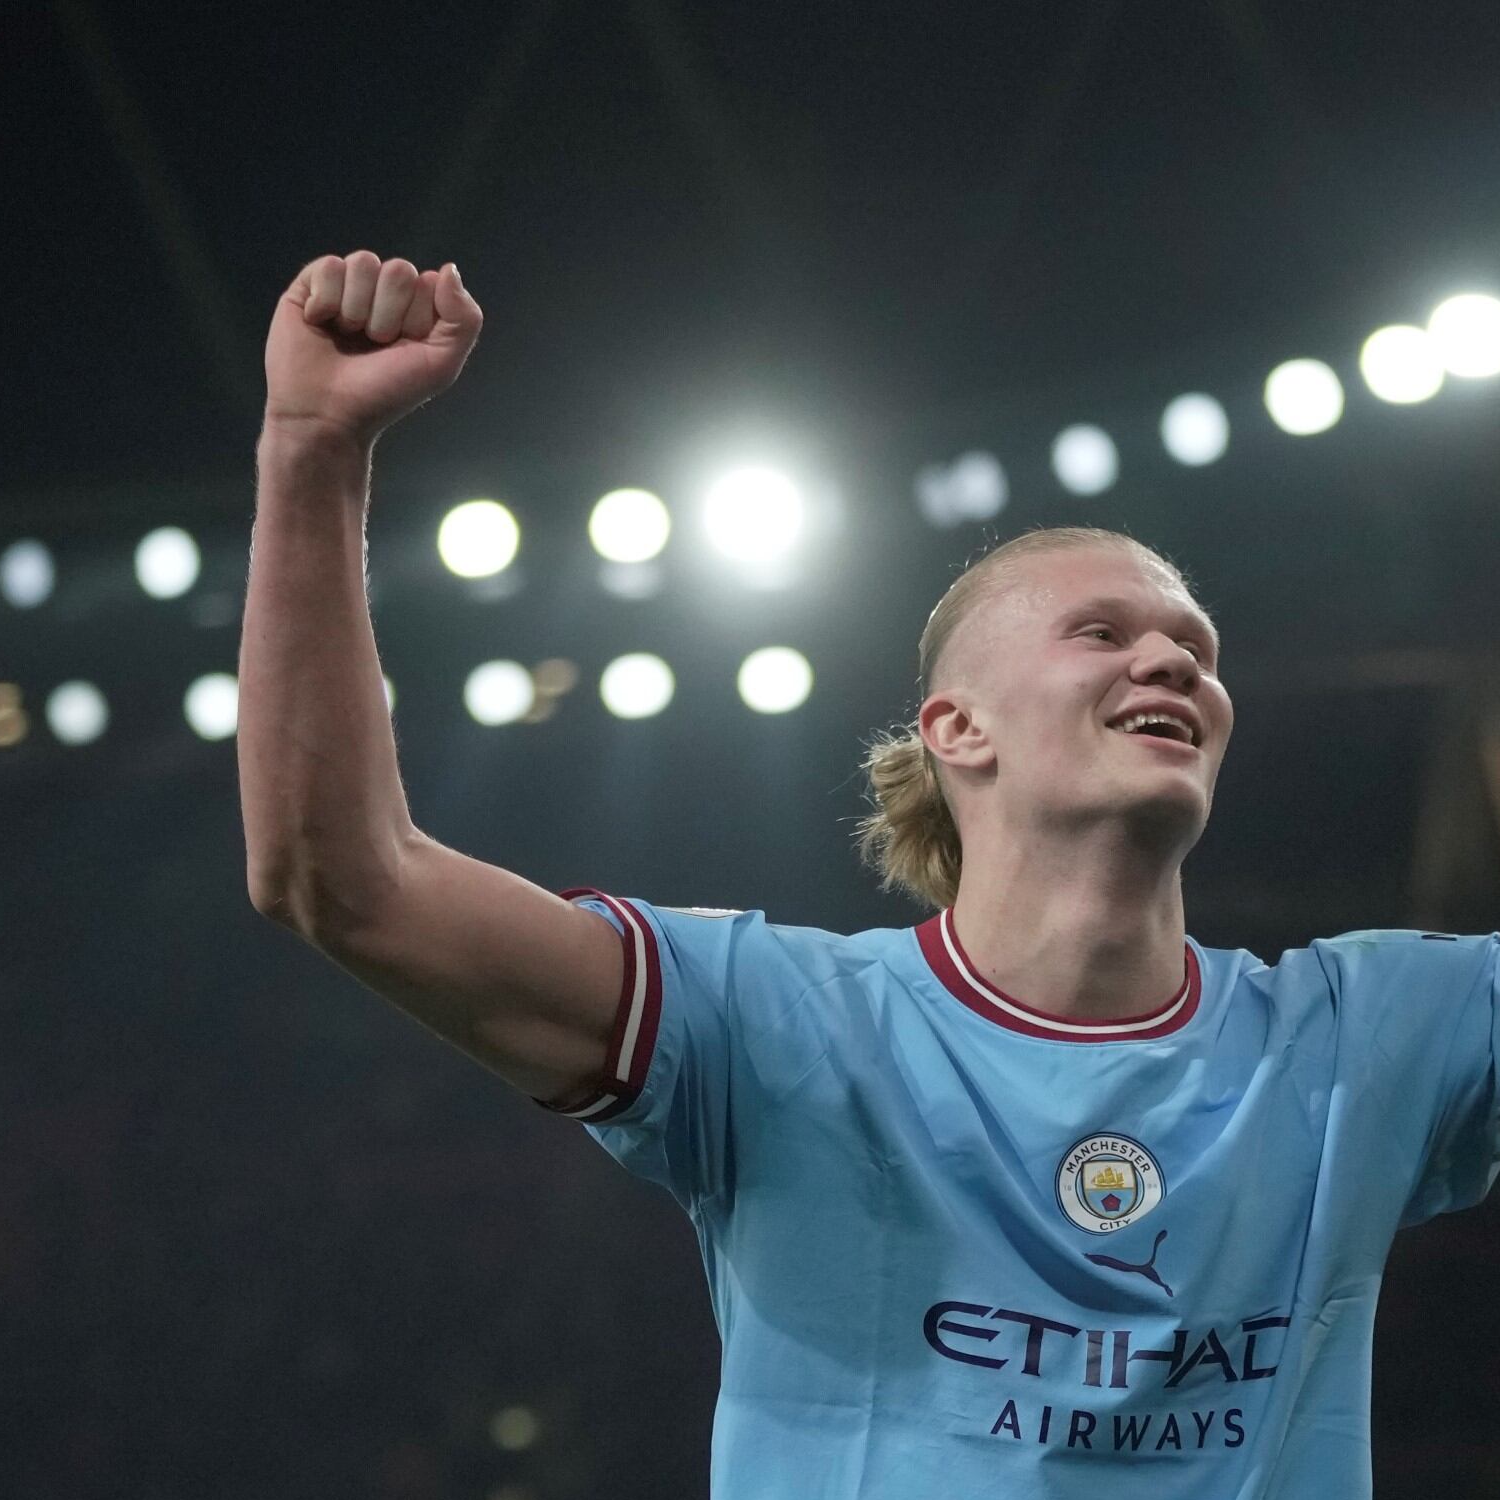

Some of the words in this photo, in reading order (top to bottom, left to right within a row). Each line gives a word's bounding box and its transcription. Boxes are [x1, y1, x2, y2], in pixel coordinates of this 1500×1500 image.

[1066, 1141, 1151, 1174] MANCHESTER
[1100, 1219, 1131, 1231] CITY
[923, 1301, 1291, 1389] ETIHAD
[990, 1400, 1245, 1451] AIRWAYS
